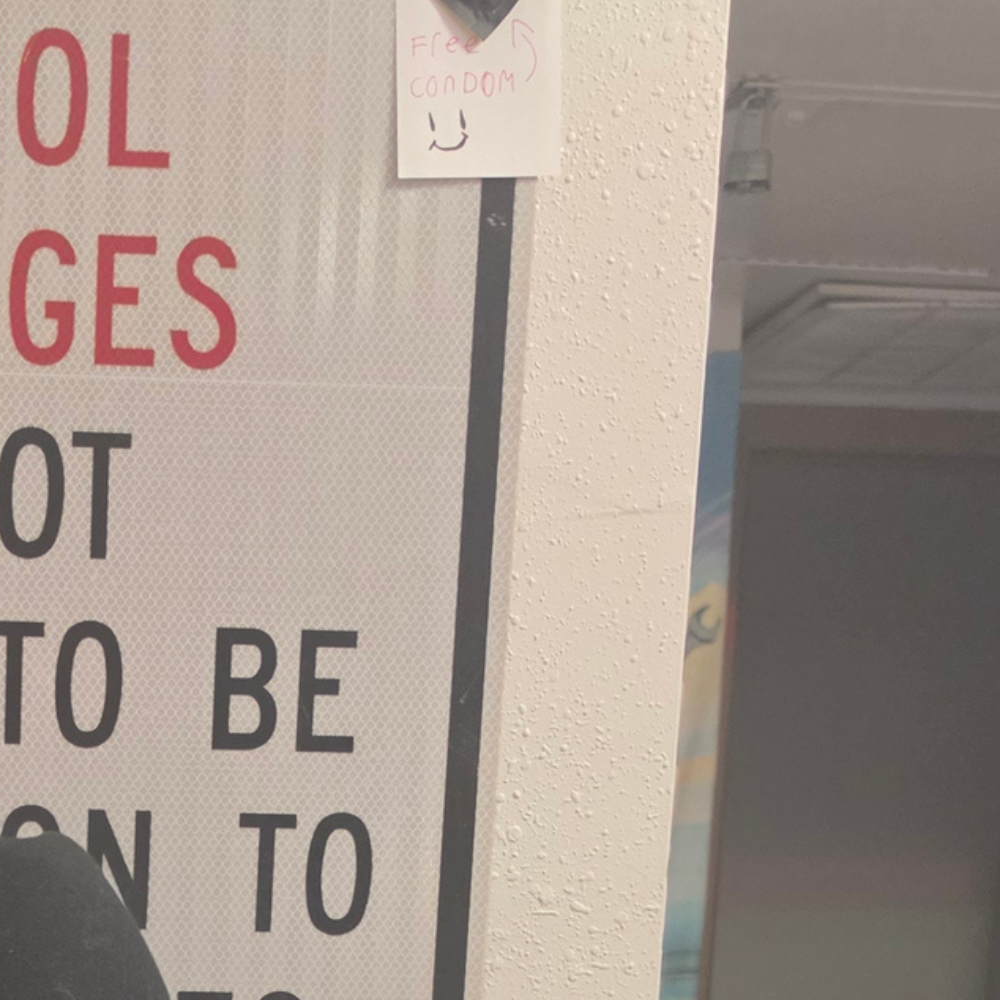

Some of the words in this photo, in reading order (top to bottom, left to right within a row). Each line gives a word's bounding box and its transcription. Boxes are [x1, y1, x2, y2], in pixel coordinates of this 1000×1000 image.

[410, 31, 480, 57] Free
[211, 627, 358, 754] BE
[1, 804, 152, 930] N
[239, 812, 373, 936] TO
